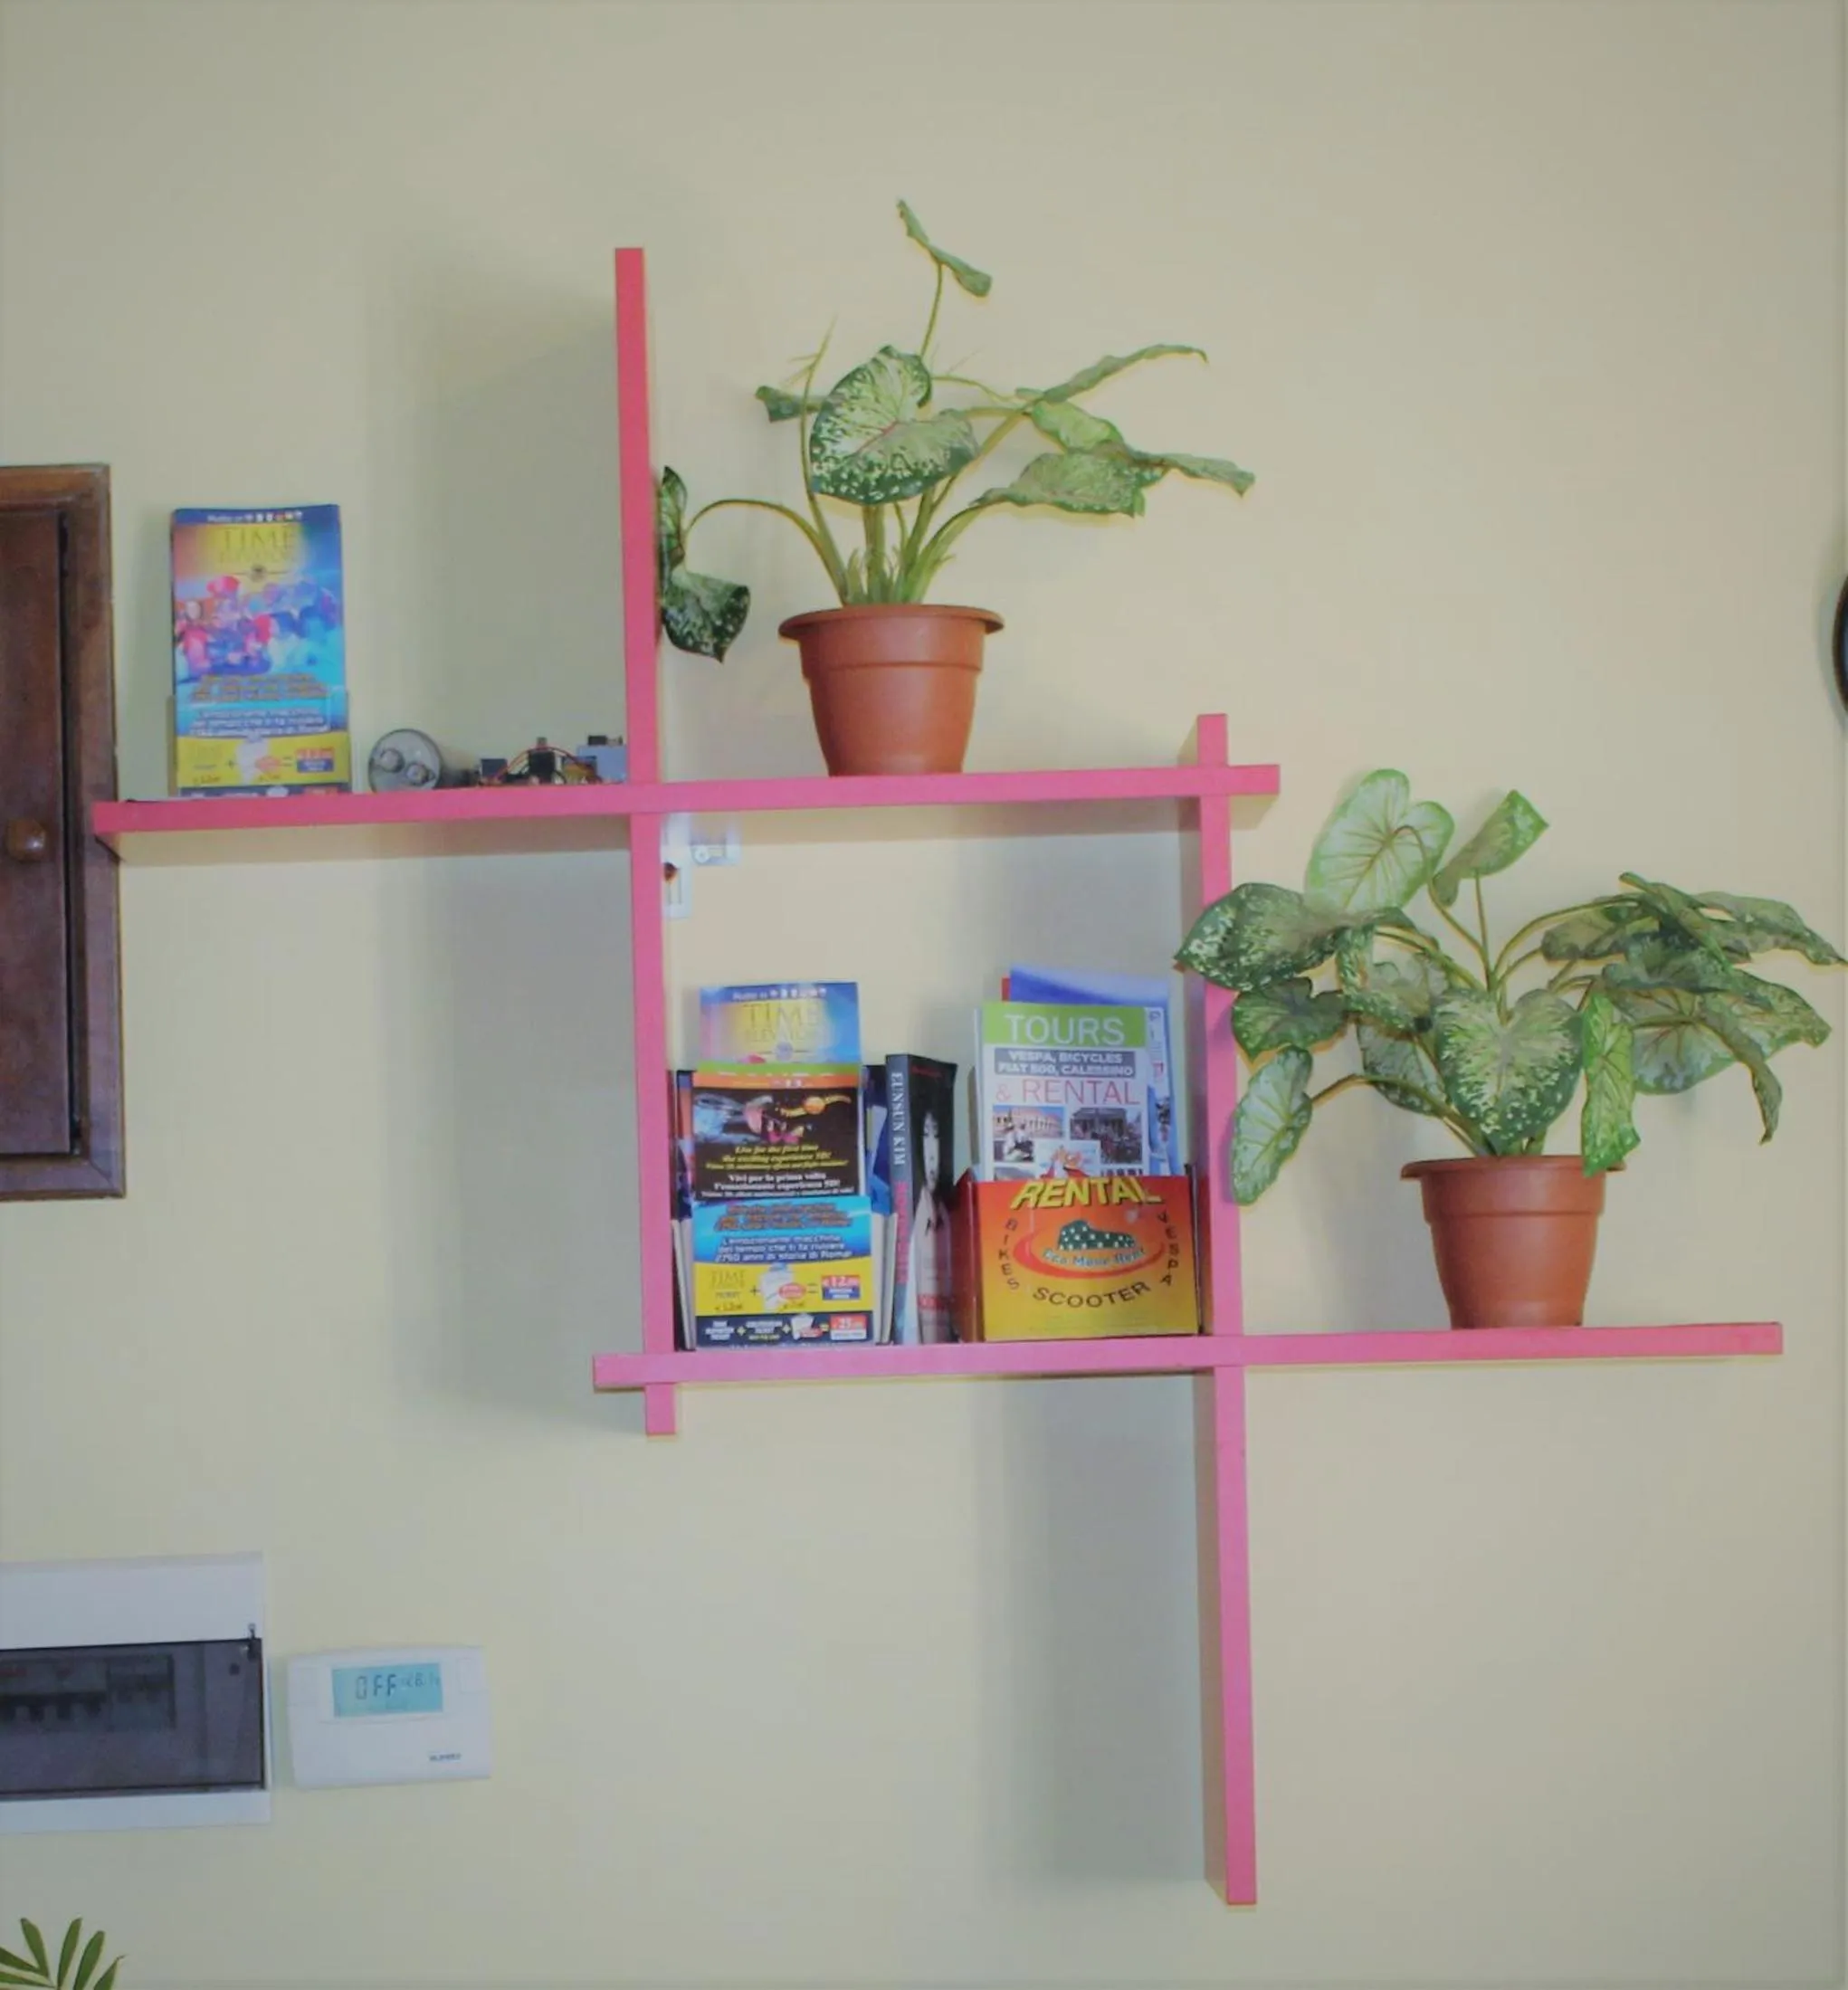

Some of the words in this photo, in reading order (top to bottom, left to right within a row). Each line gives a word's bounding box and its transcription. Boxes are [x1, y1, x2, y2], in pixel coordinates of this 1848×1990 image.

[743, 1004, 822, 1028] TIME
[1004, 1014, 1125, 1045] TOURS
[997, 1062, 1029, 1074] FIAT
[1030, 1063, 1060, 1077] 500,
[1062, 1064, 1134, 1077] CALESSINO
[1008, 1051, 1056, 1063] VESPA,
[1059, 1052, 1123, 1064] BICYCLES
[891, 1071, 904, 1130] EUNSUN
[995, 1085, 1011, 1101] &
[1023, 1079, 1142, 1106] RENTAL
[892, 1133, 905, 1166] KIM
[1010, 1177, 1165, 1211] RENTAL
[998, 1217, 1020, 1290] BIKES
[1157, 1210, 1179, 1287] VESPA
[1033, 1281, 1151, 1309] SCOOTER
[355, 1673, 396, 1700] OFF
